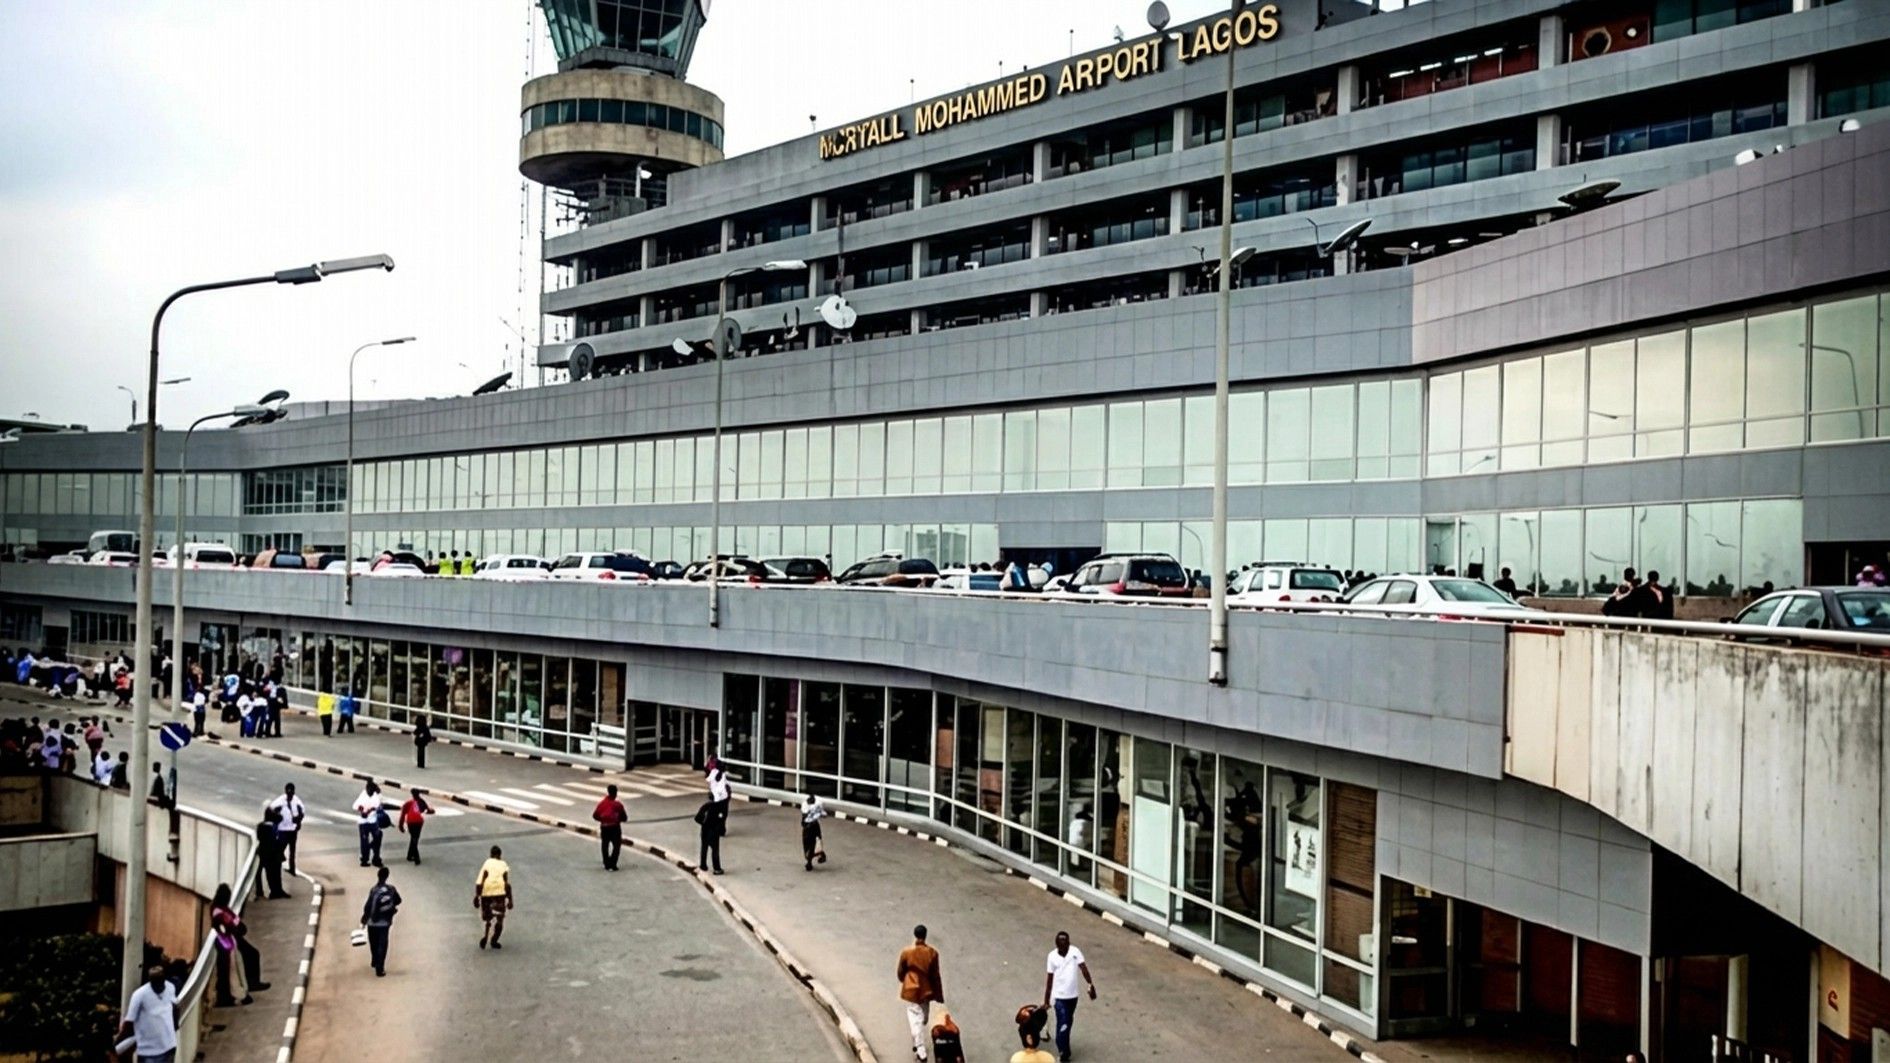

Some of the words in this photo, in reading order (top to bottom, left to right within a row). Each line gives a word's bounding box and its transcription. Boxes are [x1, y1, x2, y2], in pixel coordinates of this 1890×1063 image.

[915, 73, 1046, 134] MOHAMMED
[1057, 38, 1163, 95] ARPORT
[1178, 4, 1279, 60] LAGOS
